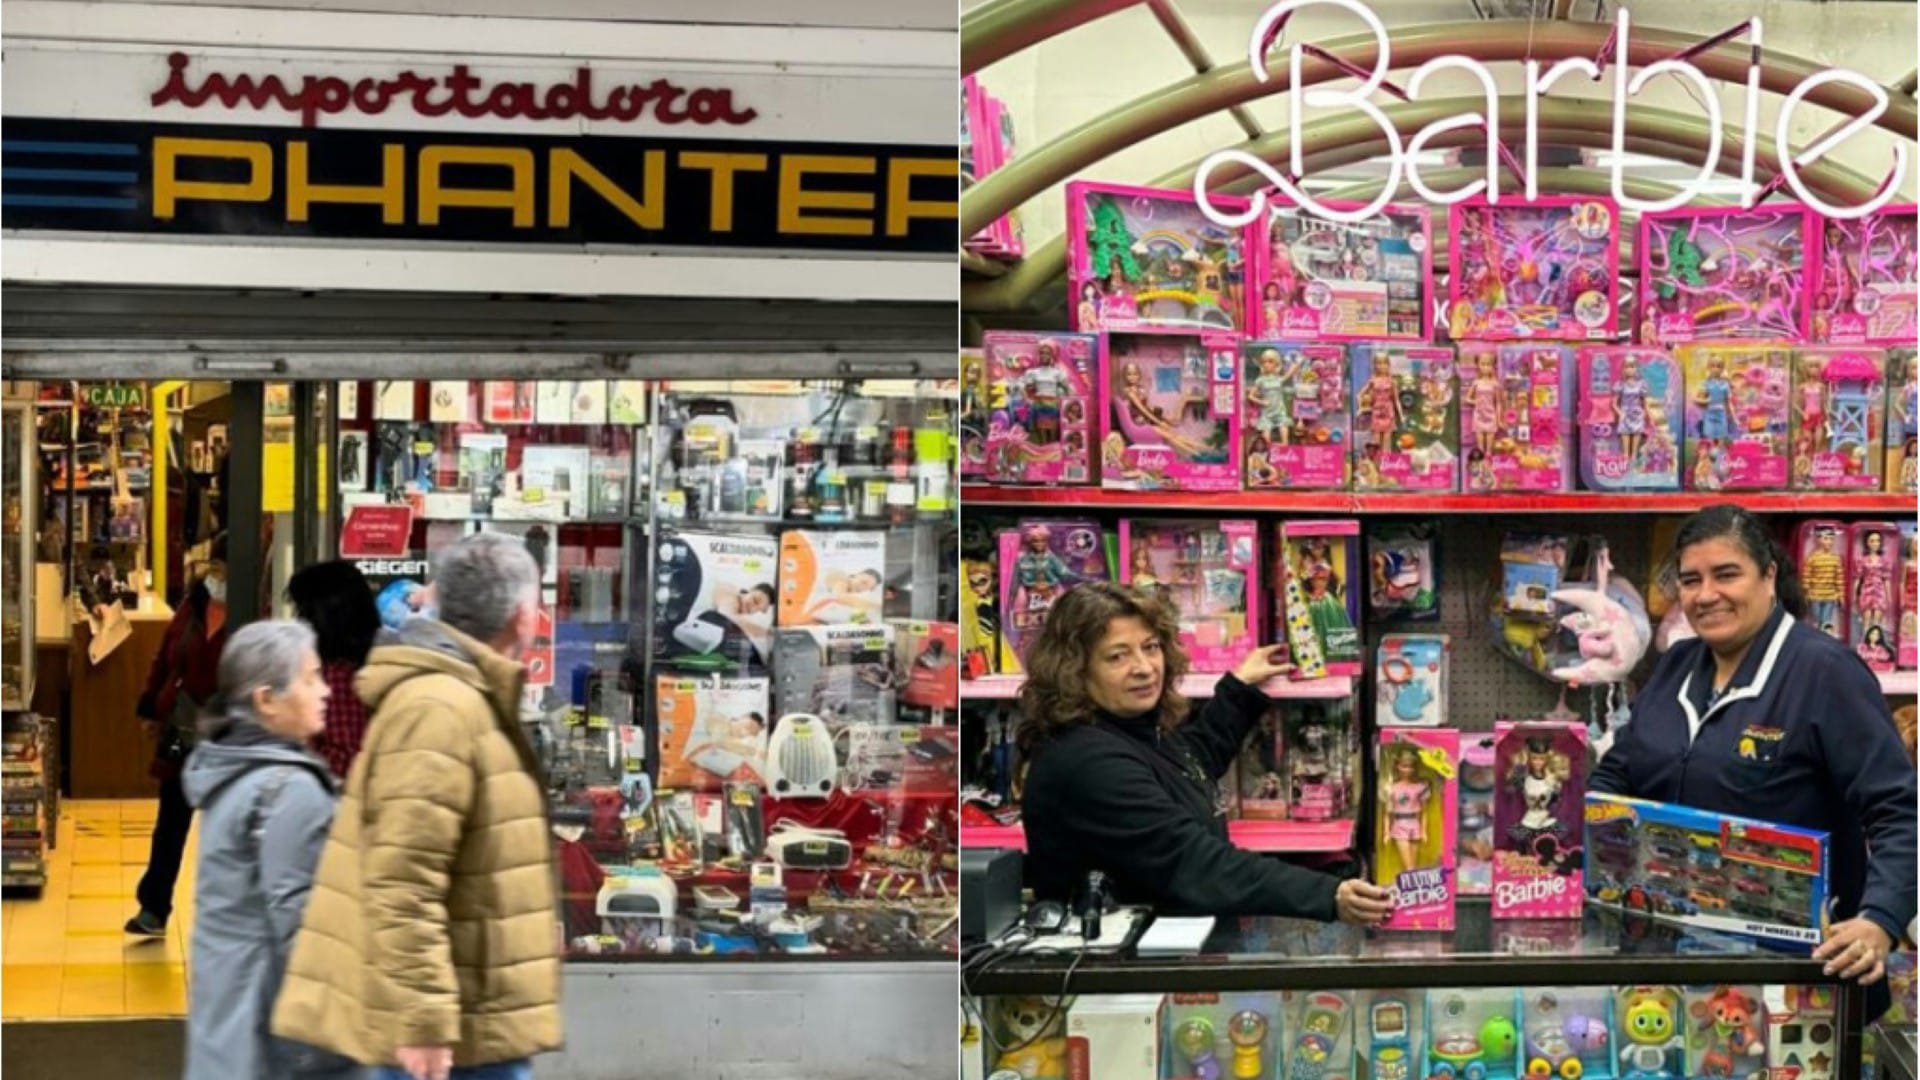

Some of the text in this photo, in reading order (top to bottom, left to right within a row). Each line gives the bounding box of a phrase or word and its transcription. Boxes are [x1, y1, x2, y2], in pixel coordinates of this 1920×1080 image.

[151, 52, 757, 127] importadora
[1194, 0, 1906, 227] Barbie
[91, 387, 140, 405] CAJA
[1387, 884, 1449, 910] Barbie
[1494, 874, 1567, 909] Barbie
